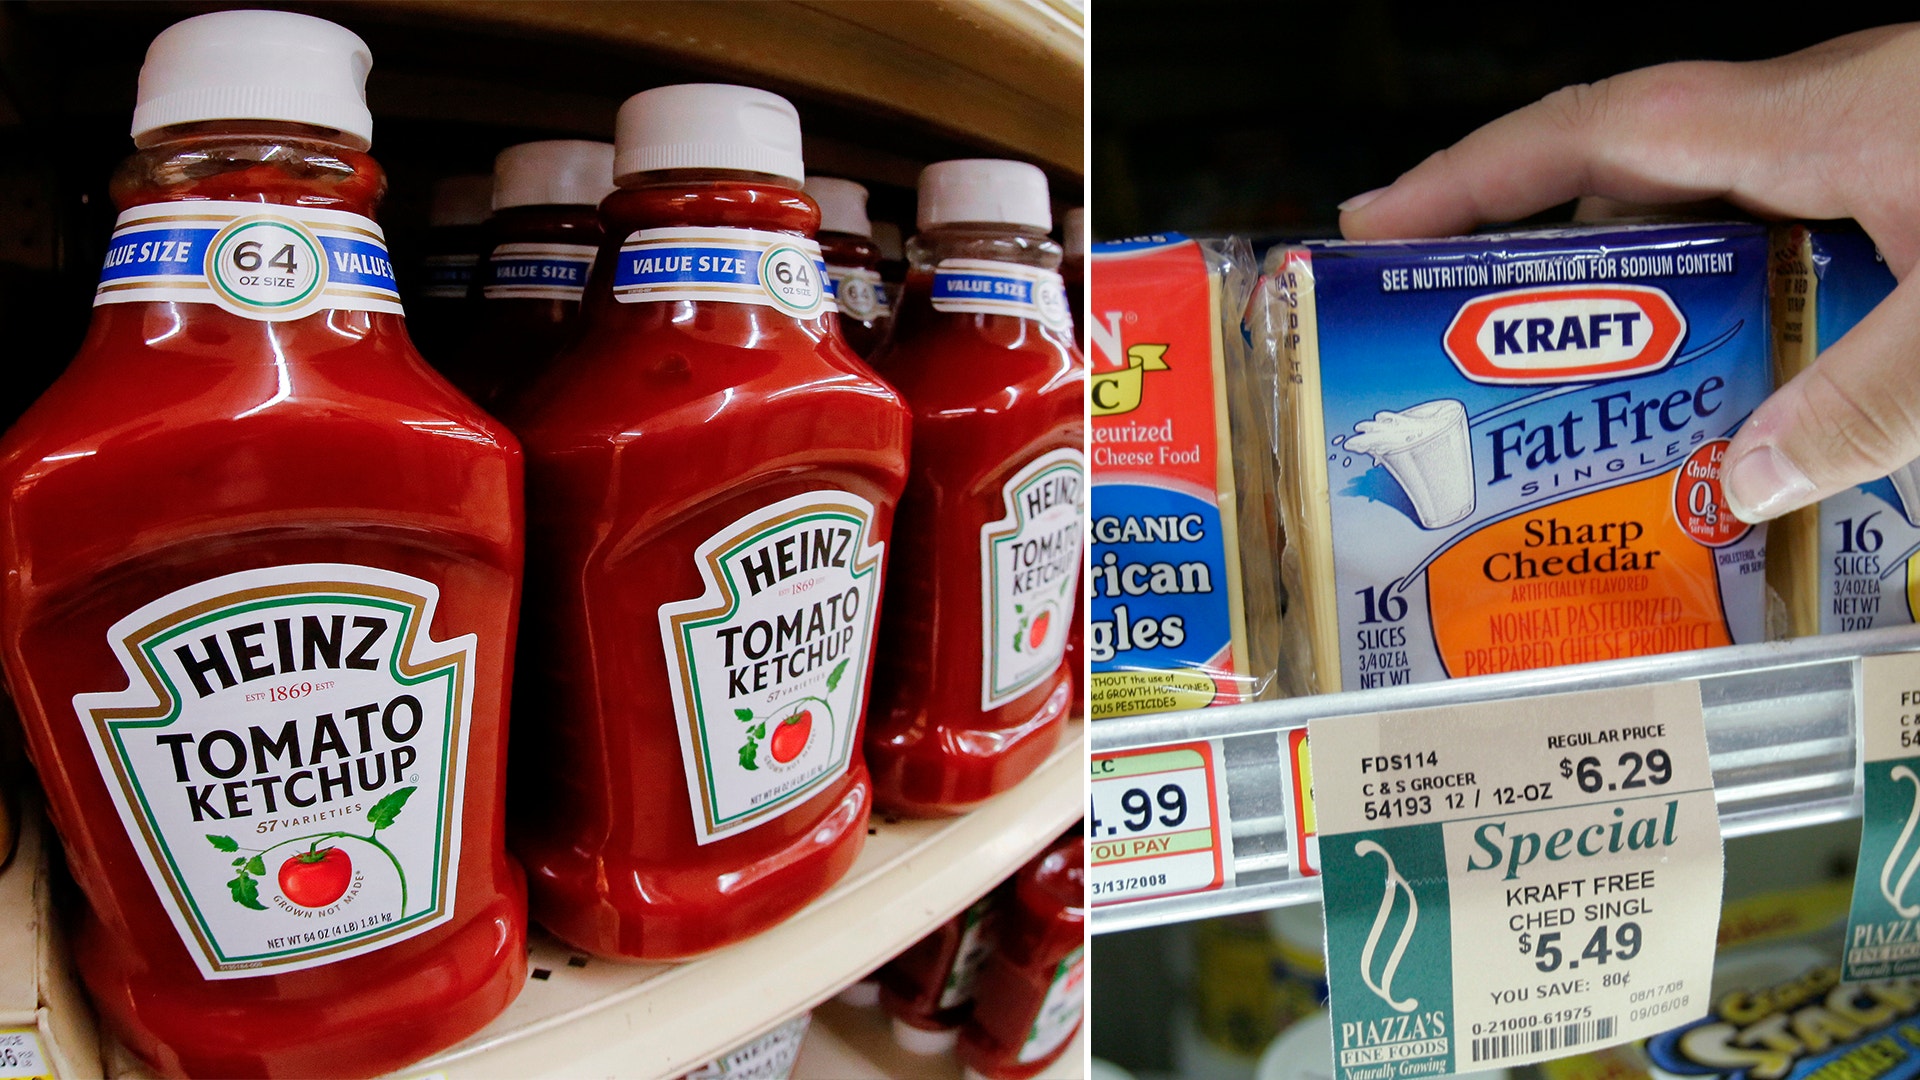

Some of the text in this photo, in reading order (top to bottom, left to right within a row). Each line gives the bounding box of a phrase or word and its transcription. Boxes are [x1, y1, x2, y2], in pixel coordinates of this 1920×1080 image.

[138, 241, 192, 264] SIZE
[233, 241, 298, 274] 64
[333, 251, 388, 275] VALUE
[633, 255, 747, 275] VALUE SIZE
[239, 276, 295, 288] OZ SIZE
[496, 266, 577, 280] VALUE SIZE
[775, 261, 811, 287] 64
[1382, 252, 1734, 292] SEE NUTRITION INFORMATION FOR SODIUM CONTENT
[782, 287, 812, 297] OZ SIZE
[947, 280, 1027, 298] VALUE SIZE
[1492, 312, 1641, 356] KRAFT
[1092, 379, 1120, 410] C
[1486, 375, 1725, 486] Fat Free
[1094, 444, 1201, 466] Cheese Food
[1521, 430, 1705, 497] SINGLES
[1710, 445, 1723, 462] Lo
[1687, 460, 1721, 480] Choles
[1688, 480, 1718, 525] 0g
[1524, 518, 1644, 550] Sharp
[1688, 517, 1700, 527] per
[1690, 525, 1715, 538] serving
[1833, 510, 1884, 554] 16
[1011, 521, 1079, 572] TOMATO
[1718, 550, 1757, 566] CHOLESTEROL
[740, 527, 852, 597] HEINZ
[1012, 550, 1075, 596] KETCHUP
[1483, 547, 1662, 583] Cheddar
[1739, 562, 1752, 576] PER
[1834, 555, 1881, 576] SLICES
[791, 578, 815, 596] 1869
[1511, 574, 1649, 604] ARTIFICIALLY FLAVORED
[1833, 579, 1852, 597] 3/4
[1354, 576, 1409, 625] 16
[1833, 595, 1882, 616] NET WT
[716, 586, 860, 668] TOMATO
[1489, 596, 1683, 646] NONFAT PASTEURIZED
[1841, 617, 1855, 632] 12
[1357, 626, 1407, 651] SLICES
[1464, 638, 1555, 678] PREPARED
[1628, 621, 1713, 656] PRODUCT
[174, 615, 389, 699] HEINZ
[728, 625, 855, 700] KETCHUP
[1359, 650, 1409, 673] 3/4 OZ EA
[268, 681, 312, 703] 1869
[766, 672, 826, 703] 57 VARIETIES
[1106, 686, 1151, 700] GROWTH
[1153, 682, 1210, 696] HORMONES
[1130, 675, 1145, 685] the
[1148, 675, 1164, 685] use
[1165, 673, 1175, 683] of
[1360, 668, 1412, 690] NET WT
[1115, 696, 1177, 713] PESTICIDES
[1900, 713, 1910, 727] C
[156, 693, 424, 783] TOMATO
[1547, 723, 1667, 750] REGULAR PRICE
[1361, 751, 1439, 774] FDS114
[1559, 748, 1673, 795] $6.29
[185, 744, 418, 822] KETCHUP
[1362, 772, 1477, 797] C & S GROCER
[1363, 782, 1554, 821] 54193 12 / 12-OZ
[256, 803, 362, 834] 57 VARIETIES
[1134, 837, 1172, 855] PAY
[1467, 799, 1680, 881] Special
[1092, 873, 1167, 895] 3/13/2008
[1506, 869, 1656, 908] KRAFT FREE
[273, 894, 313, 918] GROWN
[318, 904, 341, 918] NOT
[1509, 897, 1653, 932] CHED SINGL
[267, 912, 393, 950] NET WT 64 OZ (4 LB) 1.81 kg
[1518, 922, 1643, 974] $5.49
[1490, 970, 1632, 1006] YOU SAVE: 80¢
[1629, 979, 1684, 1004] 08/17/08
[1472, 1005, 1592, 1036] 0-21000-61975
[1629, 995, 1690, 1023] 09/06/08
[1341, 1010, 1447, 1049] PIAZZA'S
[1344, 1039, 1447, 1065] FINE FOODS
[1344, 1056, 1448, 1080] Naturally Growing
